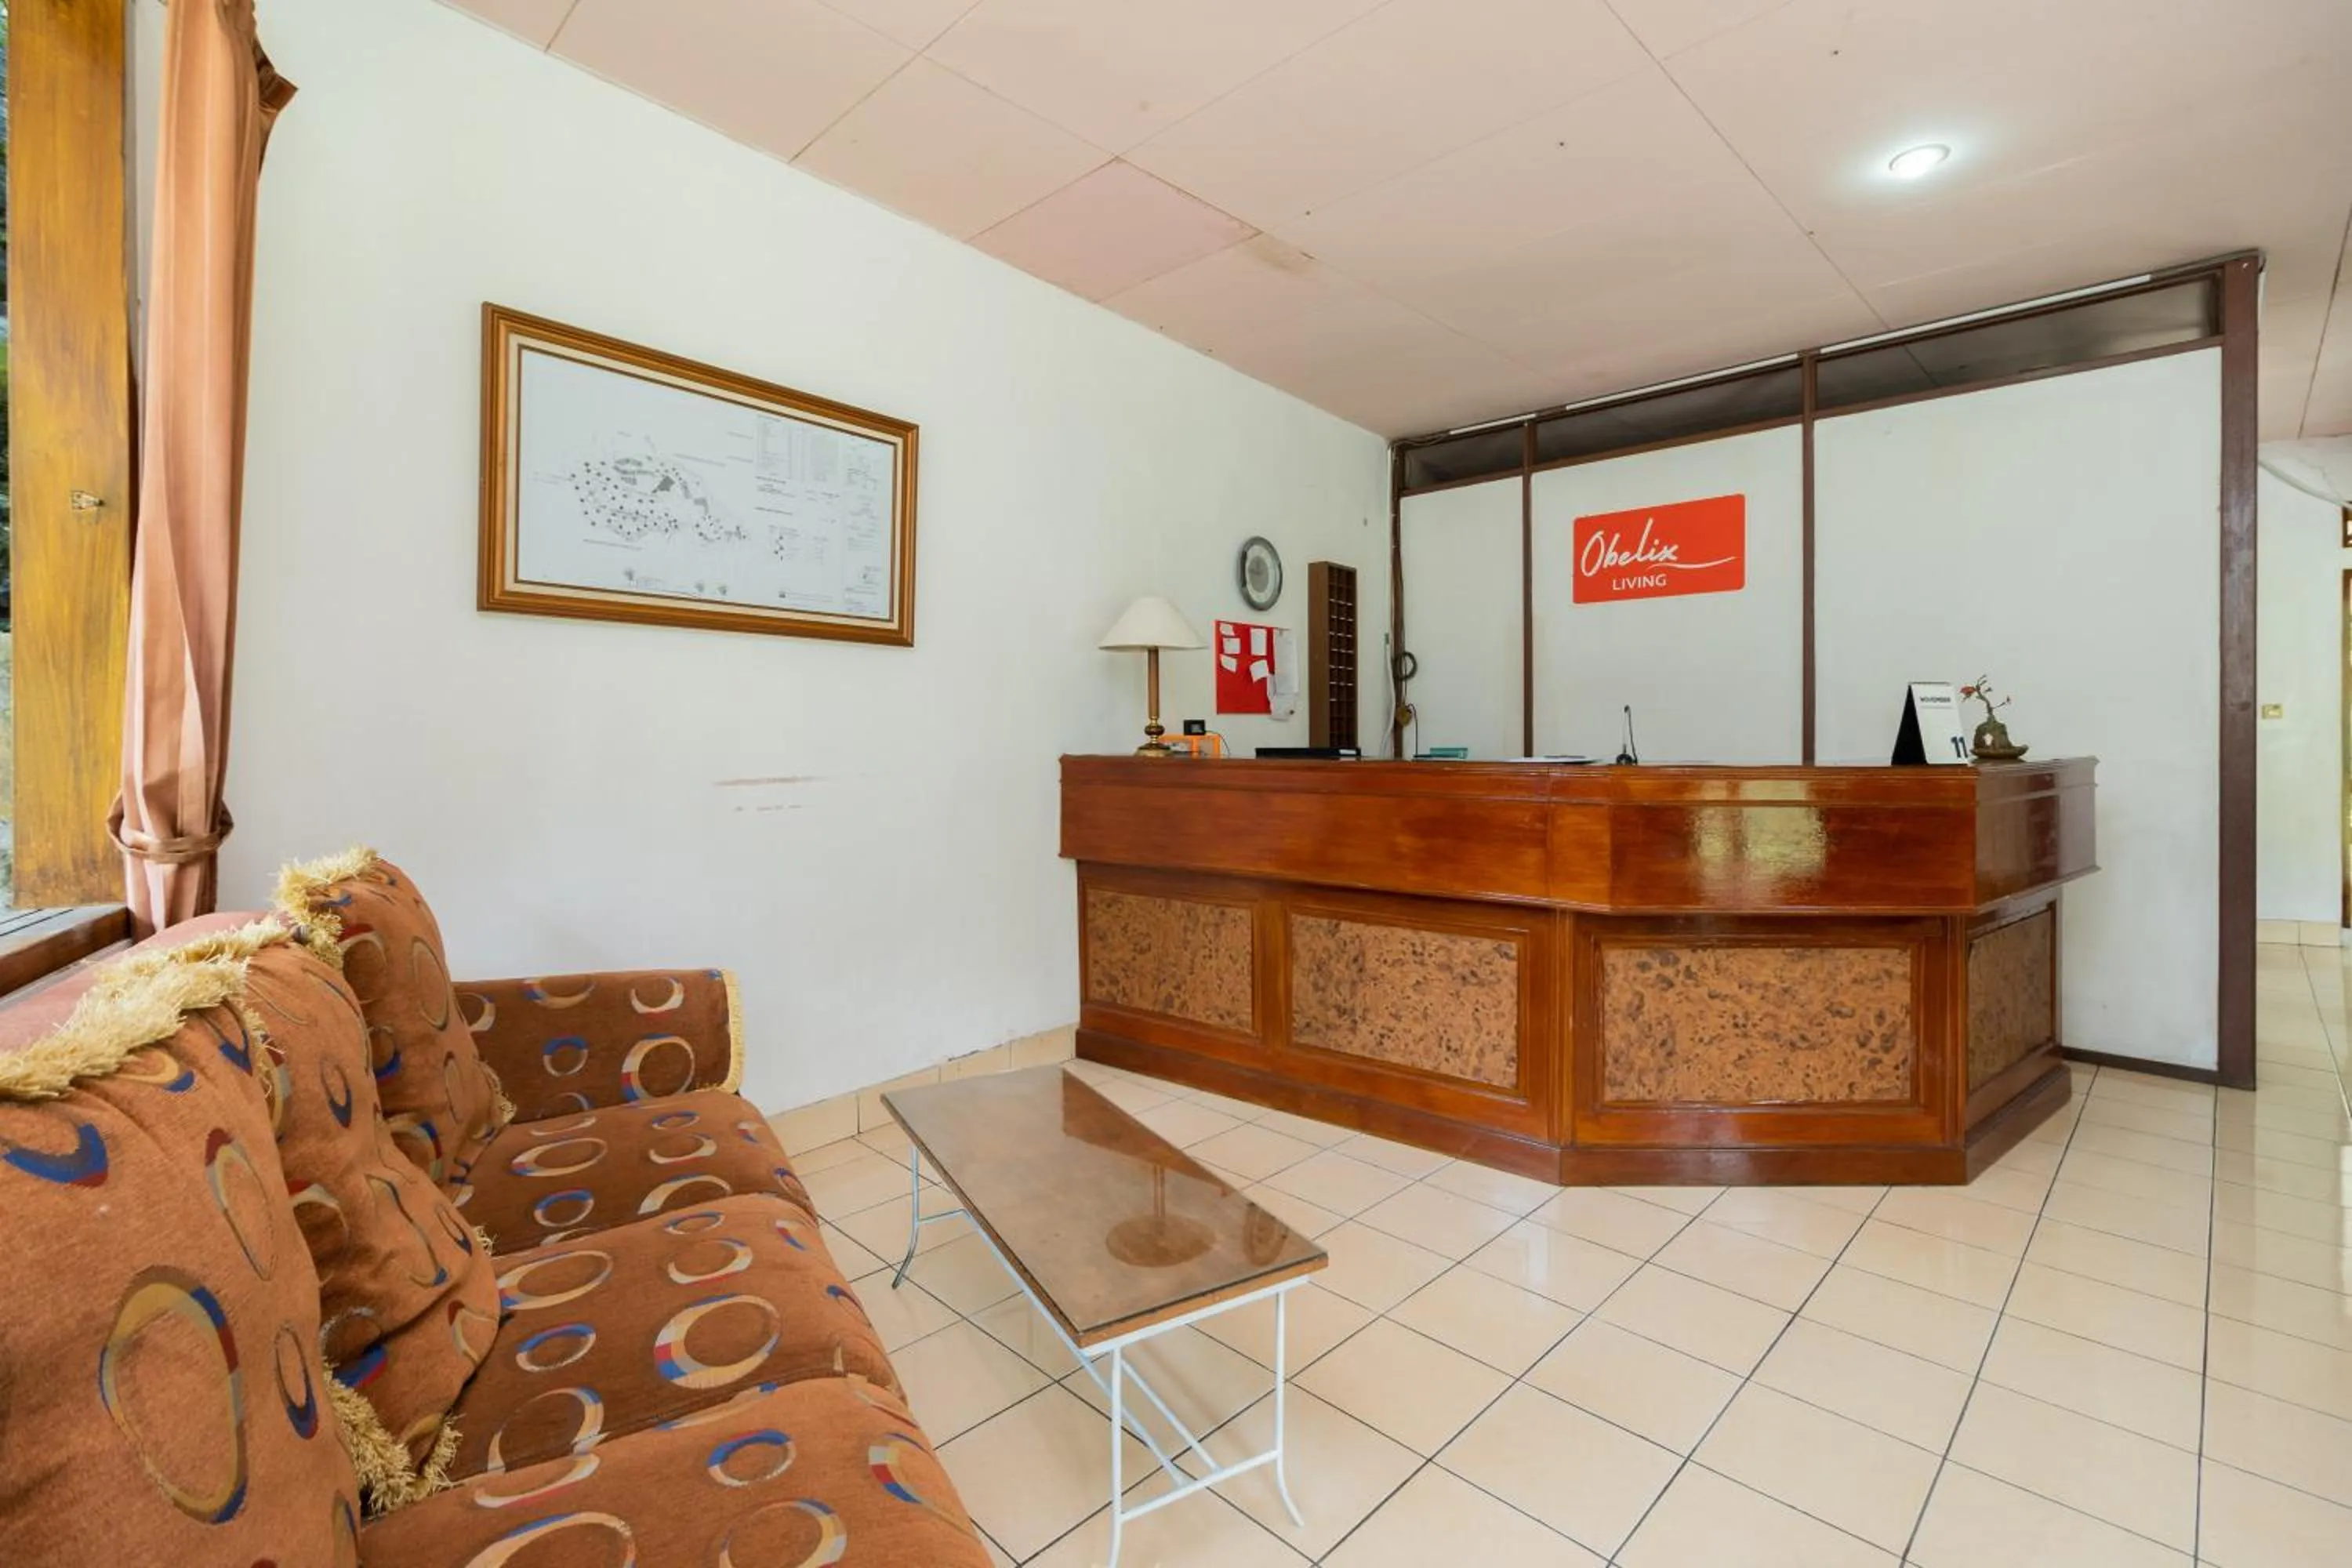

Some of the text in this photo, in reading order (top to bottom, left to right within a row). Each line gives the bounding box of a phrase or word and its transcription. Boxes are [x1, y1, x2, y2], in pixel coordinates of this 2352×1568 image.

[1581, 518, 1678, 576] Obelix
[1613, 575, 1666, 590] LIVING
[1951, 736, 1968, 758] 11
